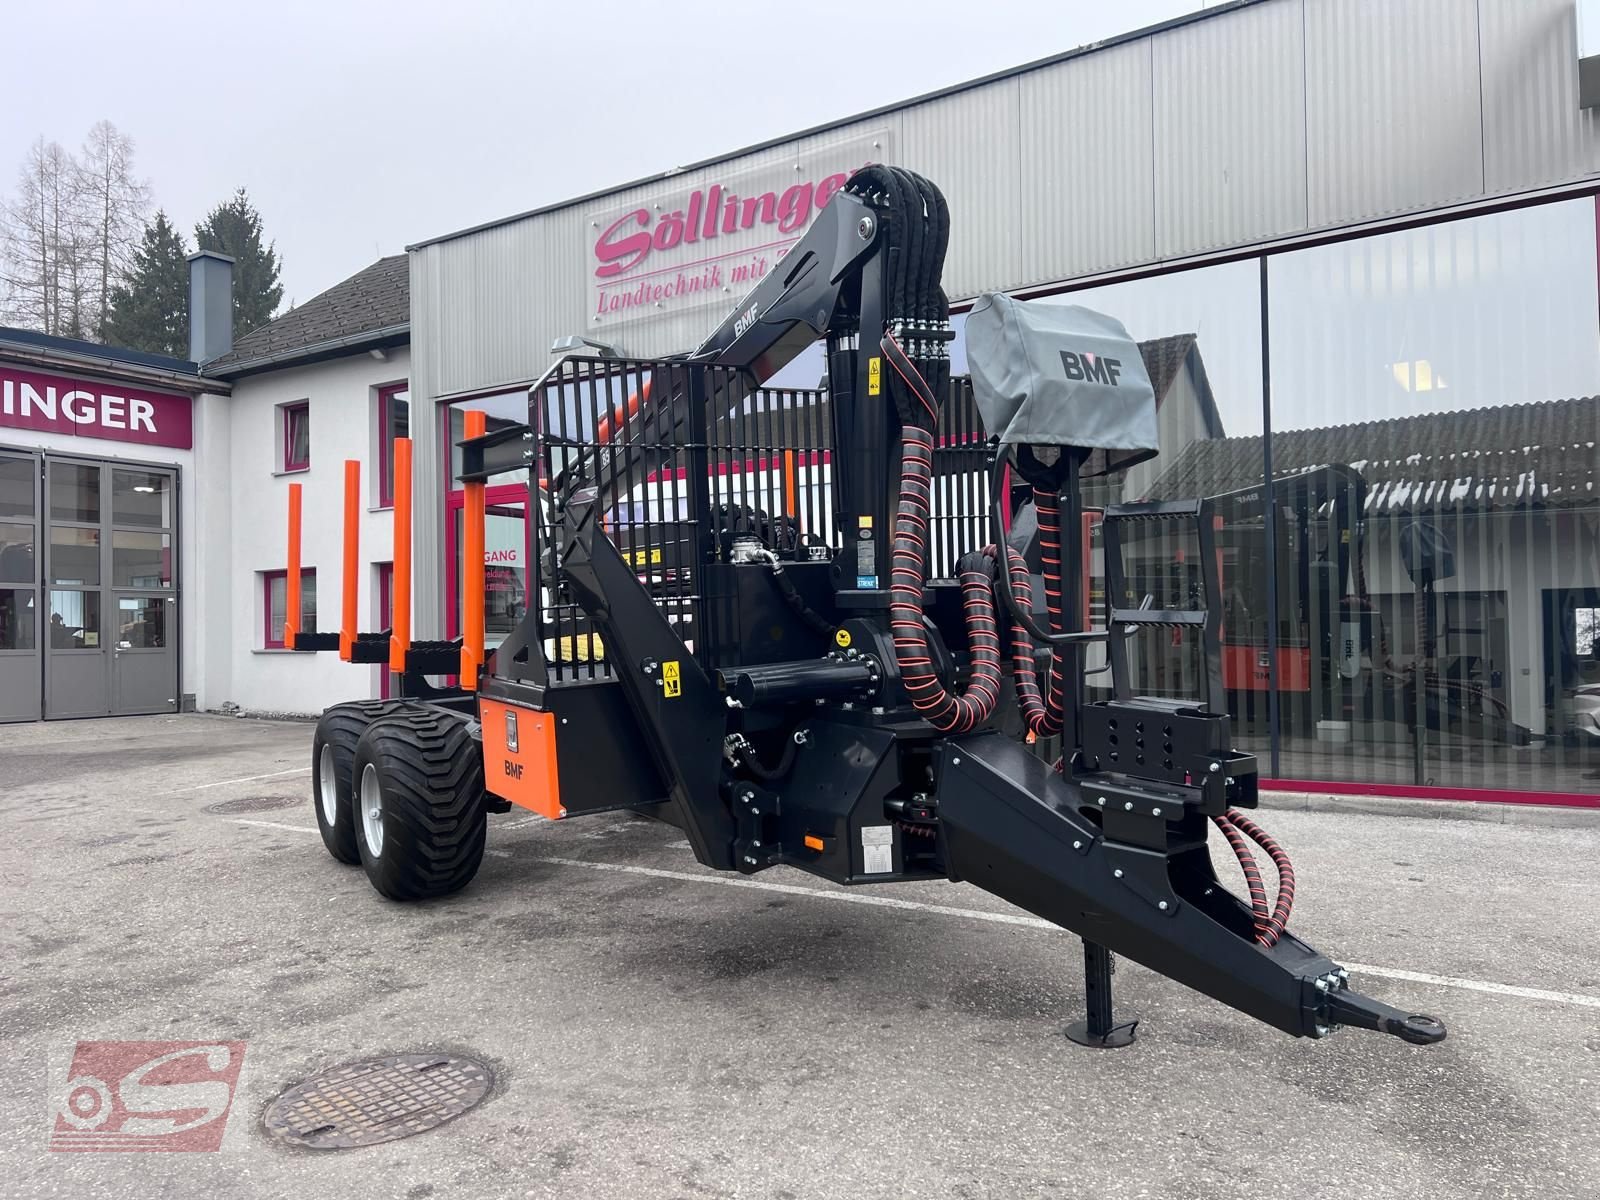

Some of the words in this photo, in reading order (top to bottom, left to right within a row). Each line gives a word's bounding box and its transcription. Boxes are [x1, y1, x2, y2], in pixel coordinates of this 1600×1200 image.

[595, 162, 872, 277] Söllinge
[597, 264, 721, 314] Landtechnik
[730, 256, 767, 284] mit
[734, 301, 758, 338] BMF
[1059, 350, 1121, 386] BMF
[3, 380, 157, 433] INGER
[505, 760, 524, 781] BMF
